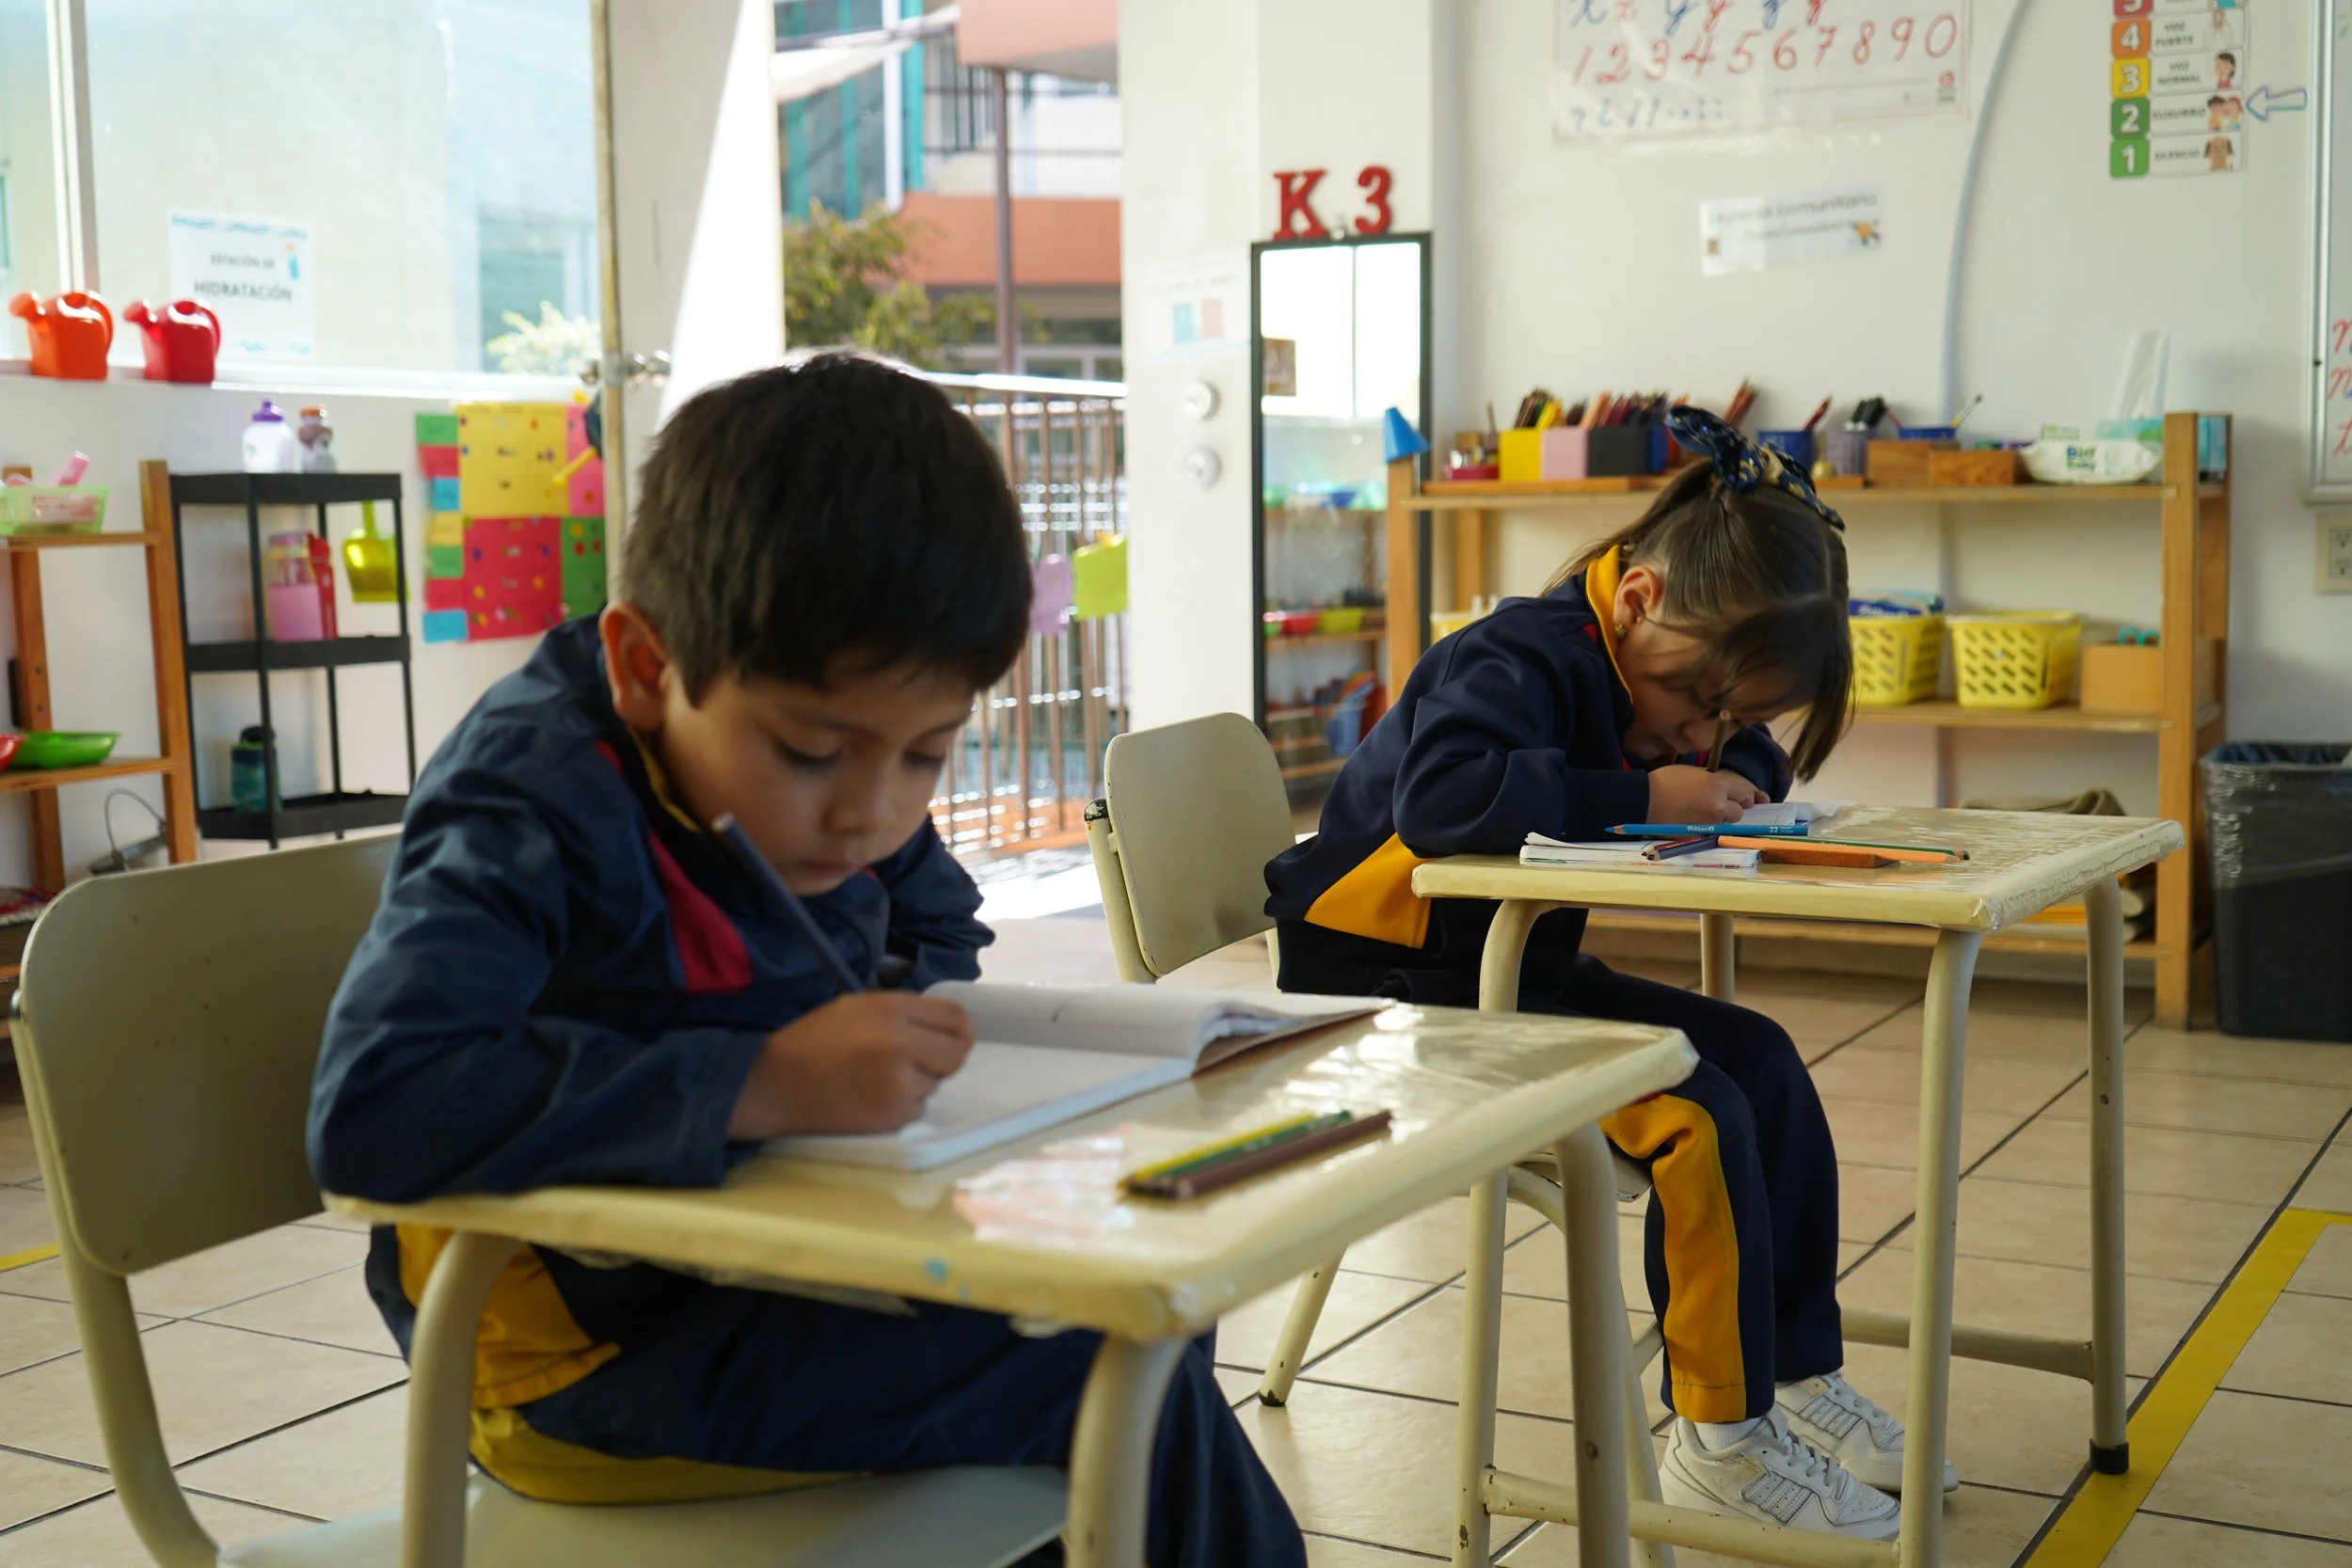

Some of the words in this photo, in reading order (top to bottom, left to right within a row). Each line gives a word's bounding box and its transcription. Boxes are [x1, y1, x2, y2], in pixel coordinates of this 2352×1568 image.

[2121, 23, 2141, 52] 4
[2121, 64, 2141, 93] 3
[2120, 103, 2140, 133] 2
[2121, 143, 2137, 173] 1
[1273, 168, 1329, 241] K
[1355, 165, 1392, 235] 3
[194, 278, 294, 303] HIDRATACIÓN
